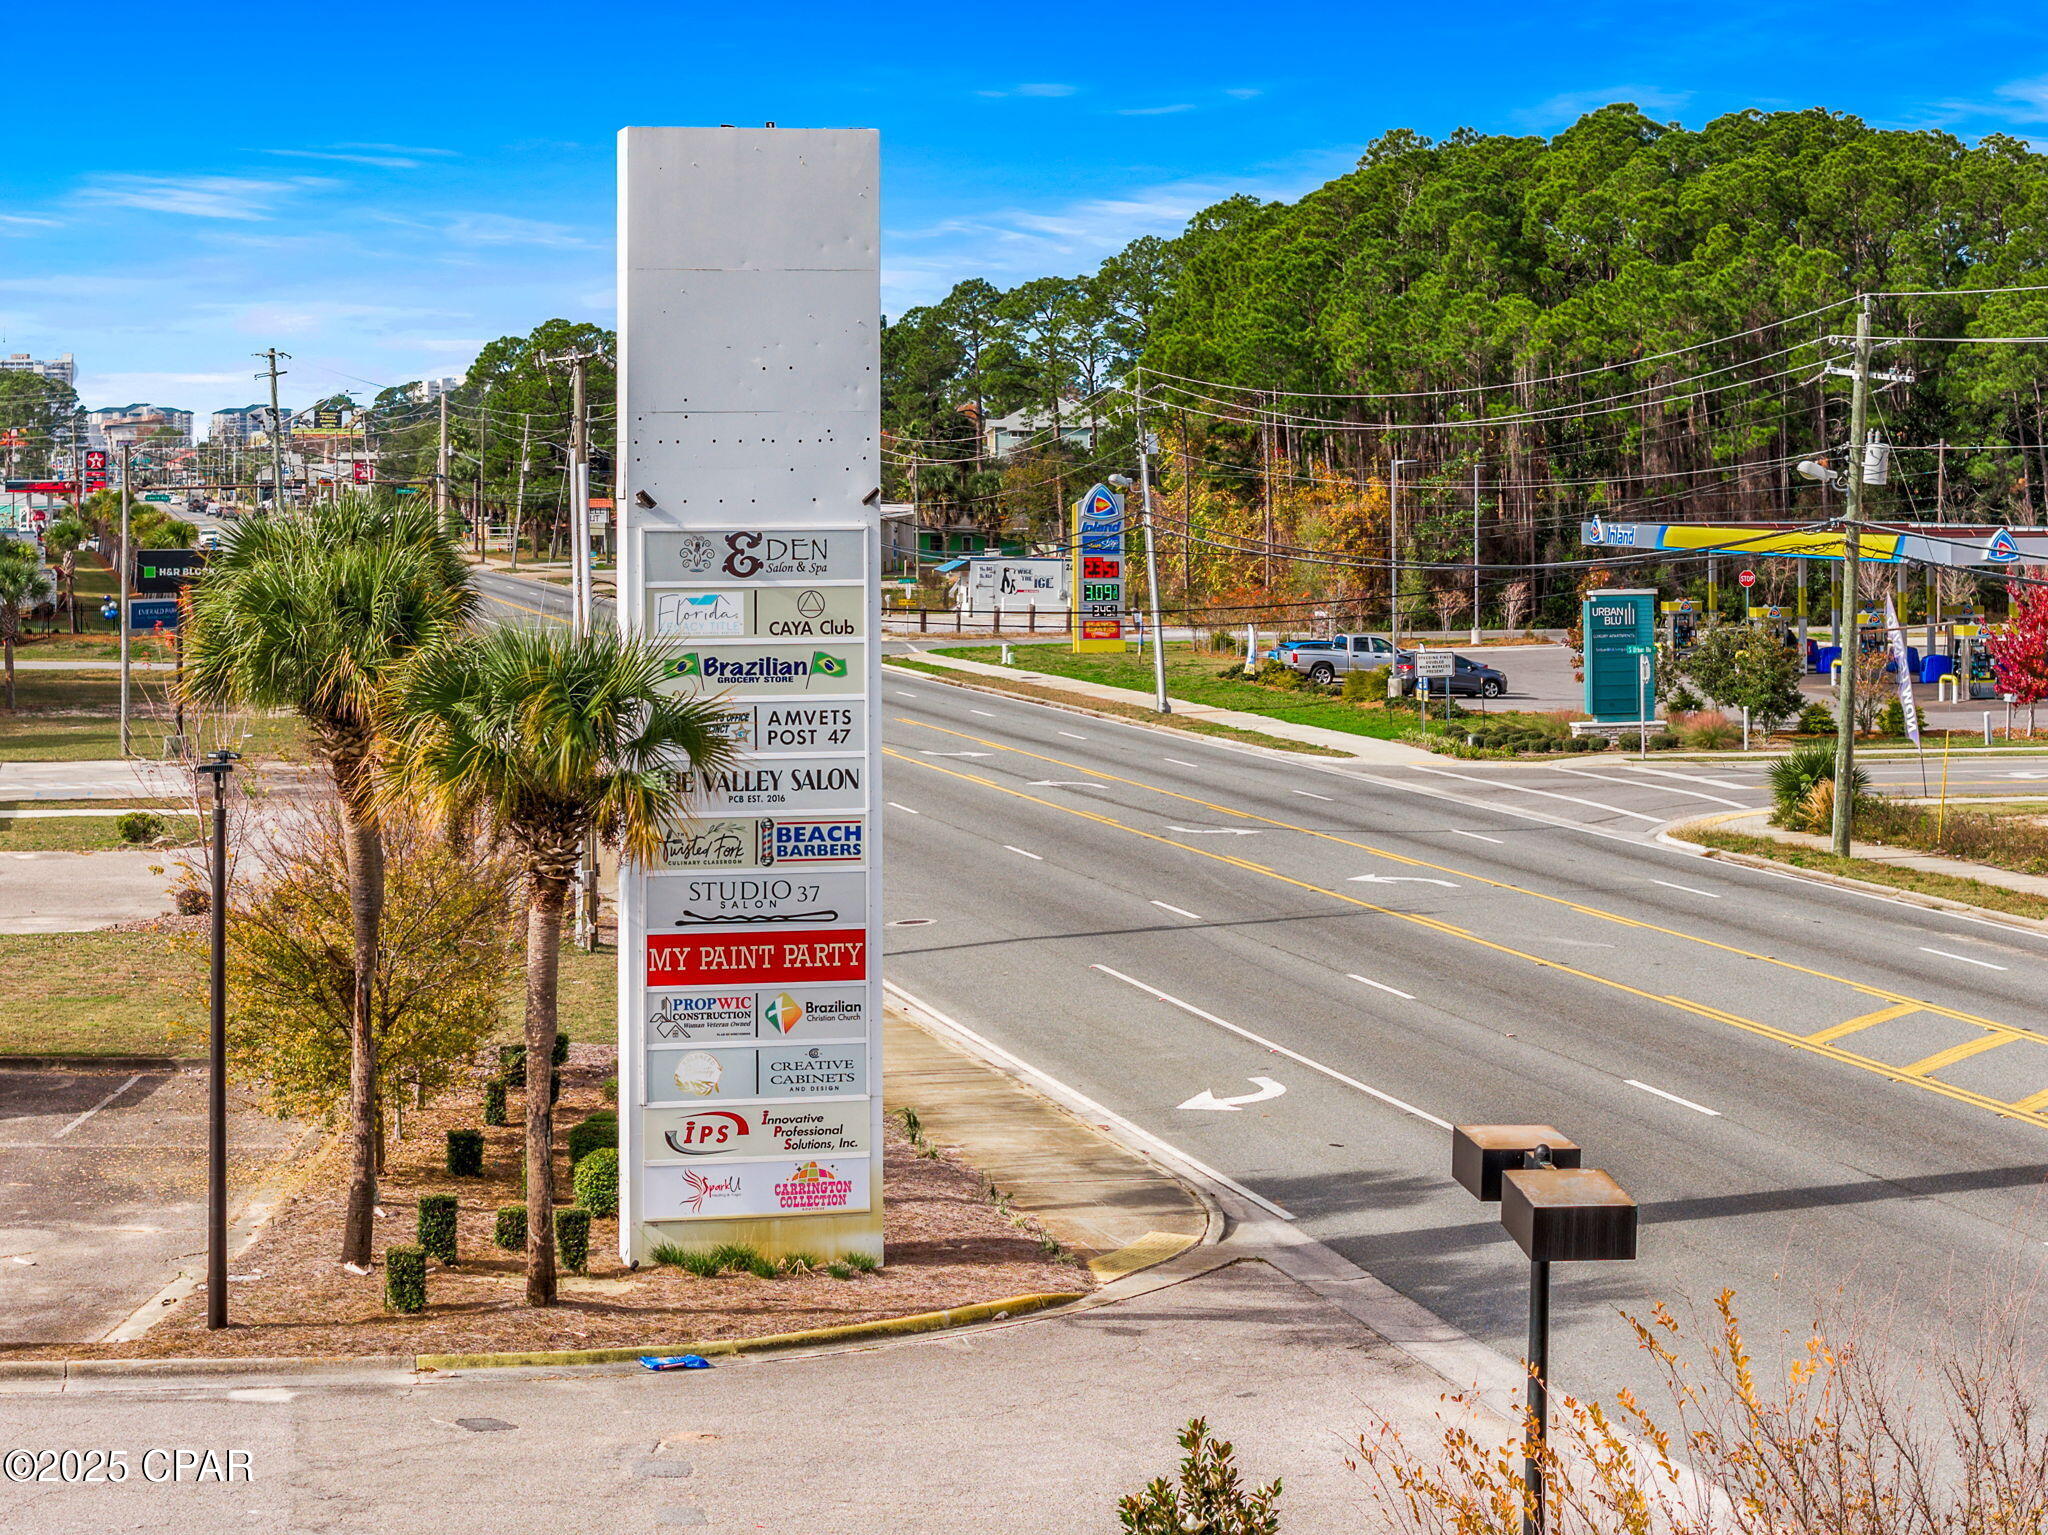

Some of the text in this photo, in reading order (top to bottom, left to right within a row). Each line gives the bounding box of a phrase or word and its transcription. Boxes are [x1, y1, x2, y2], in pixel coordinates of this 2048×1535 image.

[1607, 525, 1635, 545] Inland
[159, 567, 180, 576] H&R
[766, 561, 827, 575] Salon & Spa
[1592, 607, 1624, 617] URBAN
[708, 621, 740, 632] TITLE
[769, 619, 854, 635] CAYA Club
[1604, 616, 1622, 626] BLU
[703, 656, 807, 677] Brazilian
[717, 676, 760, 684] GROCERY
[726, 713, 750, 722] OFFICE
[768, 709, 851, 725] AMVETS
[767, 729, 851, 746] POST 47
[702, 769, 783, 793] VALLEY
[791, 767, 860, 792] SALON
[728, 794, 785, 803] PCB EST. 2016
[776, 825, 862, 844] BEACH
[714, 833, 745, 860] Fork
[776, 843, 862, 858] BARBERS
[689, 880, 820, 902] STUDIO 37
[720, 900, 777, 909] SALON
[649, 942, 863, 972] MY PAINT PARTY
[673, 996, 752, 1011] PROPWIC
[805, 1001, 862, 1014] Brazilian
[672, 1011, 752, 1021] CONSTRUCTION
[806, 1013, 861, 1022] Christian Church
[770, 1059, 854, 1072] CREATIVE
[770, 1073, 855, 1084] CABINETS
[773, 1124, 843, 1138] Professional
[784, 1137, 858, 1151] Solutions, Inc.
[774, 1180, 852, 1196] CARRINGTON
[780, 1194, 847, 1208] COLLECTION
